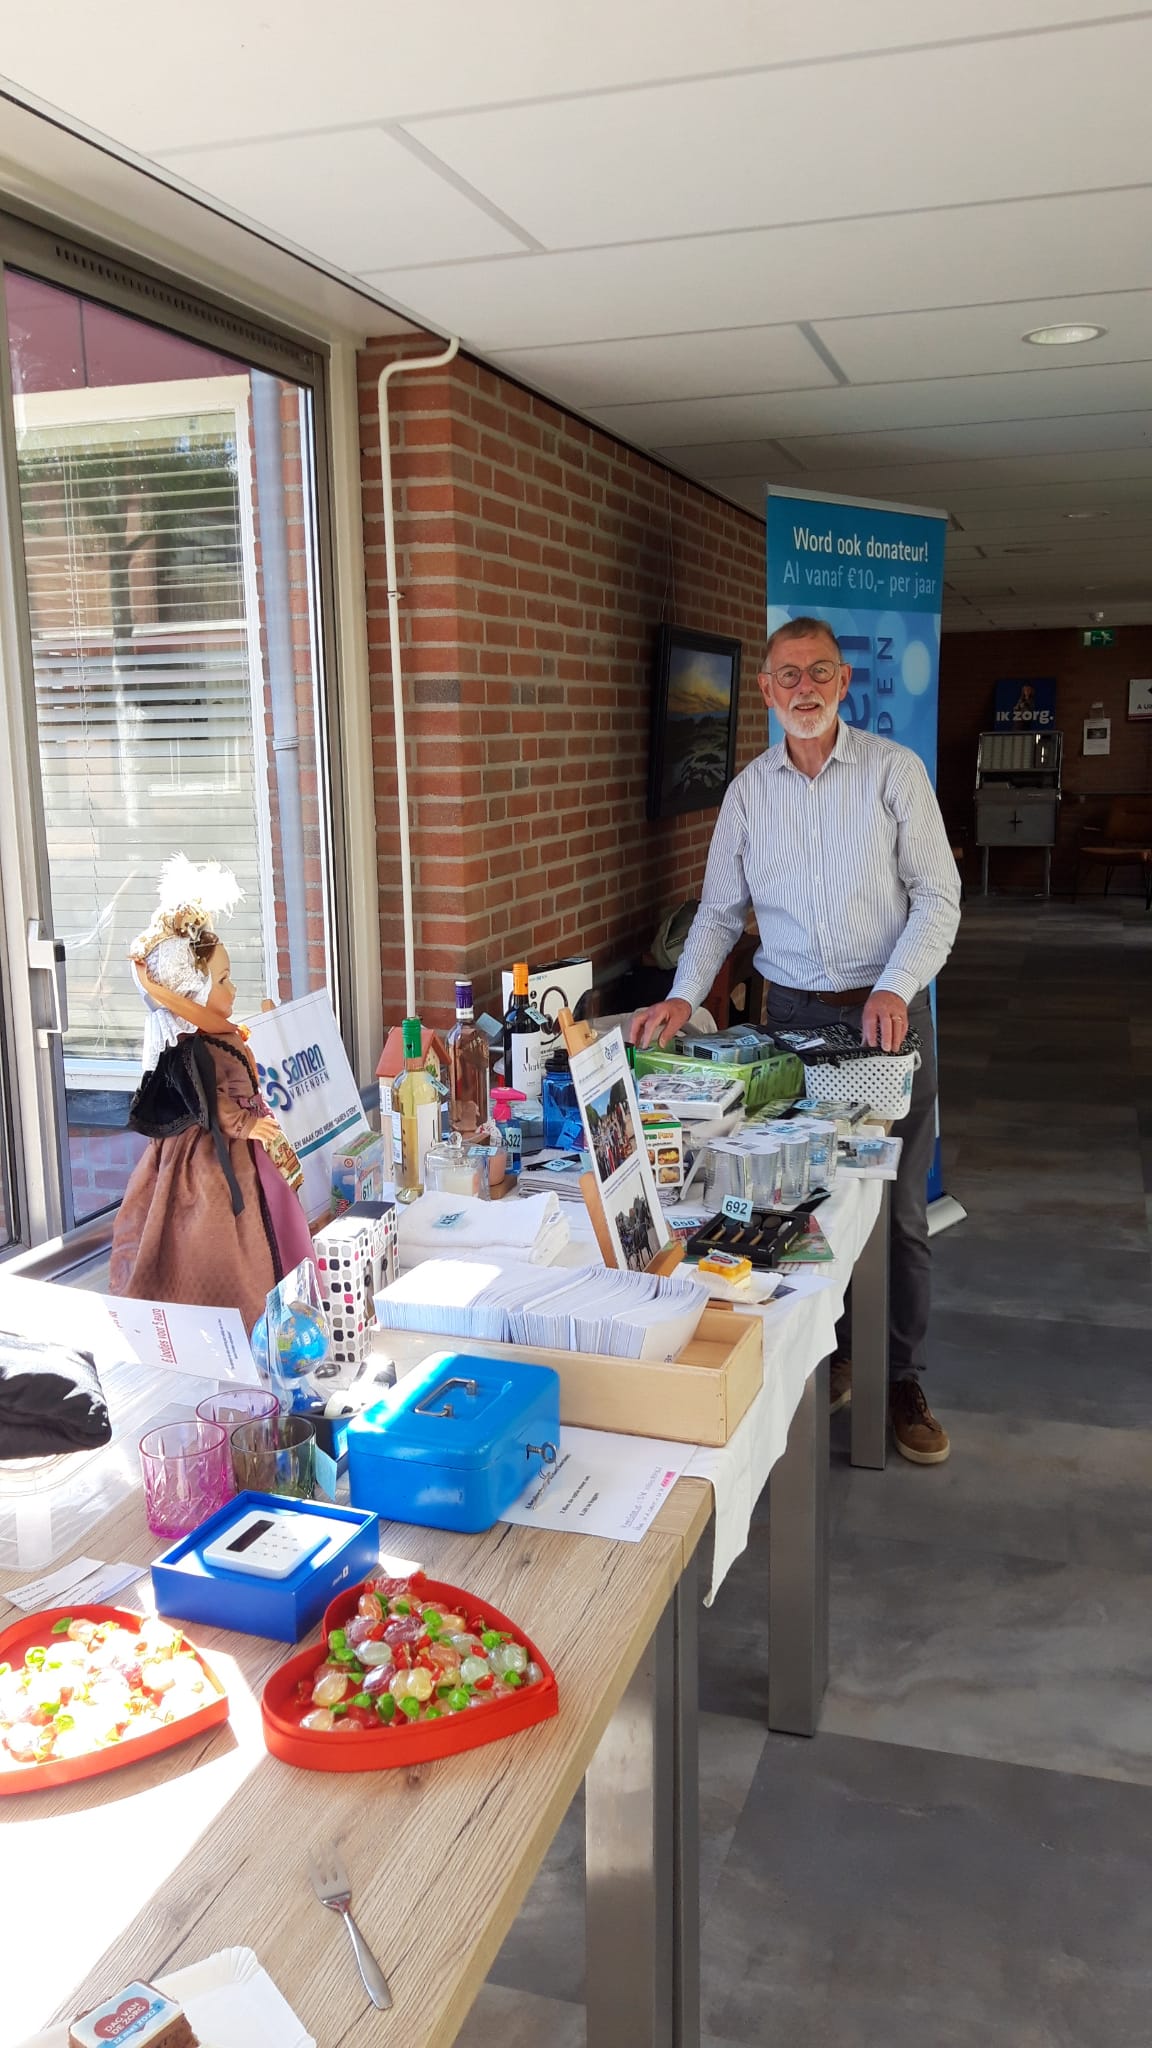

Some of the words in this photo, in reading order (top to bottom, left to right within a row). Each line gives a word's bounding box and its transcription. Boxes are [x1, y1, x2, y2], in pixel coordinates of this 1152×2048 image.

[793, 526, 833, 553] Word
[837, 533, 862, 556] ook
[866, 535, 929, 563] donateur!
[783, 560, 800, 585] Al
[805, 565, 844, 588] vanaf
[847, 568, 885, 593] €10,-
[889, 575, 911, 597] per
[914, 572, 937, 599] jaar
[1012, 710, 1054, 725] zorg.
[288, 1070, 330, 1099] VRIENDEN
[508, 1133, 521, 1147] 322
[362, 1178, 373, 1201] 611
[725, 1200, 748, 1215] 692
[151, 1308, 163, 1321] euro
[155, 1326, 167, 1339] voor
[104, 2017, 123, 2032] DAG
[121, 2002, 140, 2017] VAN
[111, 2025, 125, 2035] DE
[122, 2005, 146, 2025] ZORG
